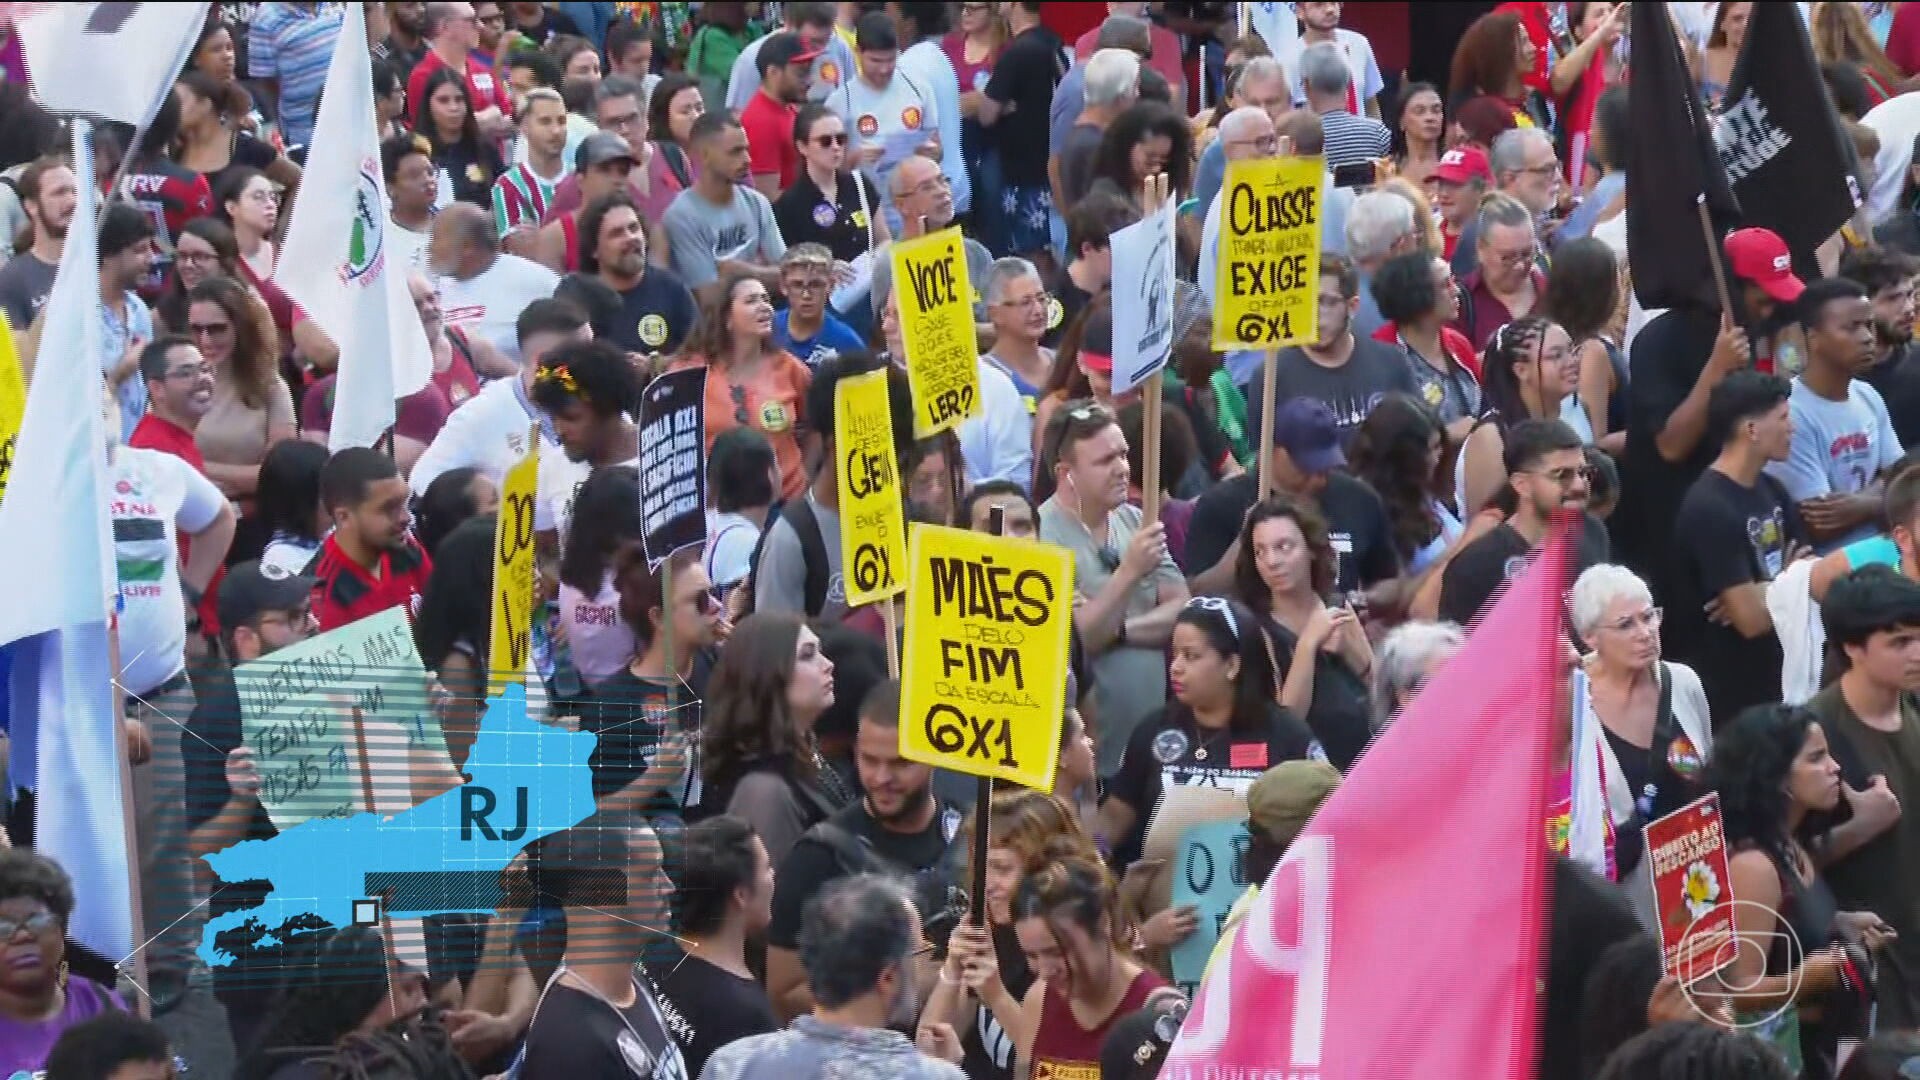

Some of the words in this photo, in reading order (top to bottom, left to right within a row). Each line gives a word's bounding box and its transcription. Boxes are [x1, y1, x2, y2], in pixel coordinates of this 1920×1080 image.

[1230, 182, 1316, 236] CLASSE
[1231, 254, 1308, 297] EXIGE
[1235, 310, 1293, 343] 6X1
[928, 384, 974, 425] LER?
[574, 605, 617, 627] GASPAR
[929, 554, 1055, 627] MÃES
[245, 642, 356, 721] QUEREMOS
[362, 624, 415, 671] MAIS
[940, 638, 1024, 691] FIM
[934, 680, 963, 700] DA
[965, 683, 1042, 710] ESCALA
[253, 706, 329, 762] TEMPO
[925, 703, 1019, 769] 6X1
